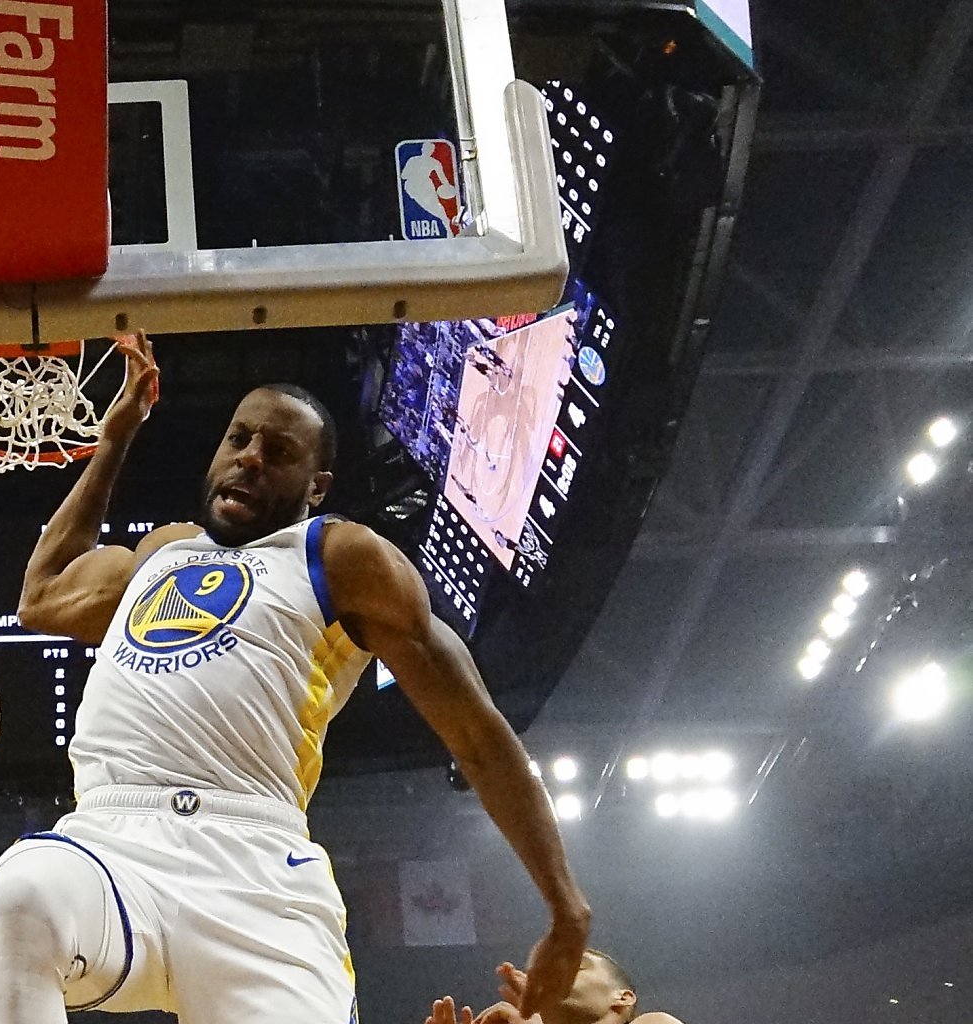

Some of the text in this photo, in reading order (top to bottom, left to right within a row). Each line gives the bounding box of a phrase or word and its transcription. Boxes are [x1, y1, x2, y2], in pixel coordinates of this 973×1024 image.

[410, 220, 440, 237] NBA
[567, 401, 587, 429] 4
[147, 550, 269, 583] GOLDEN STATE
[193, 569, 226, 597] 9
[112, 630, 238, 675] WARRIORS
